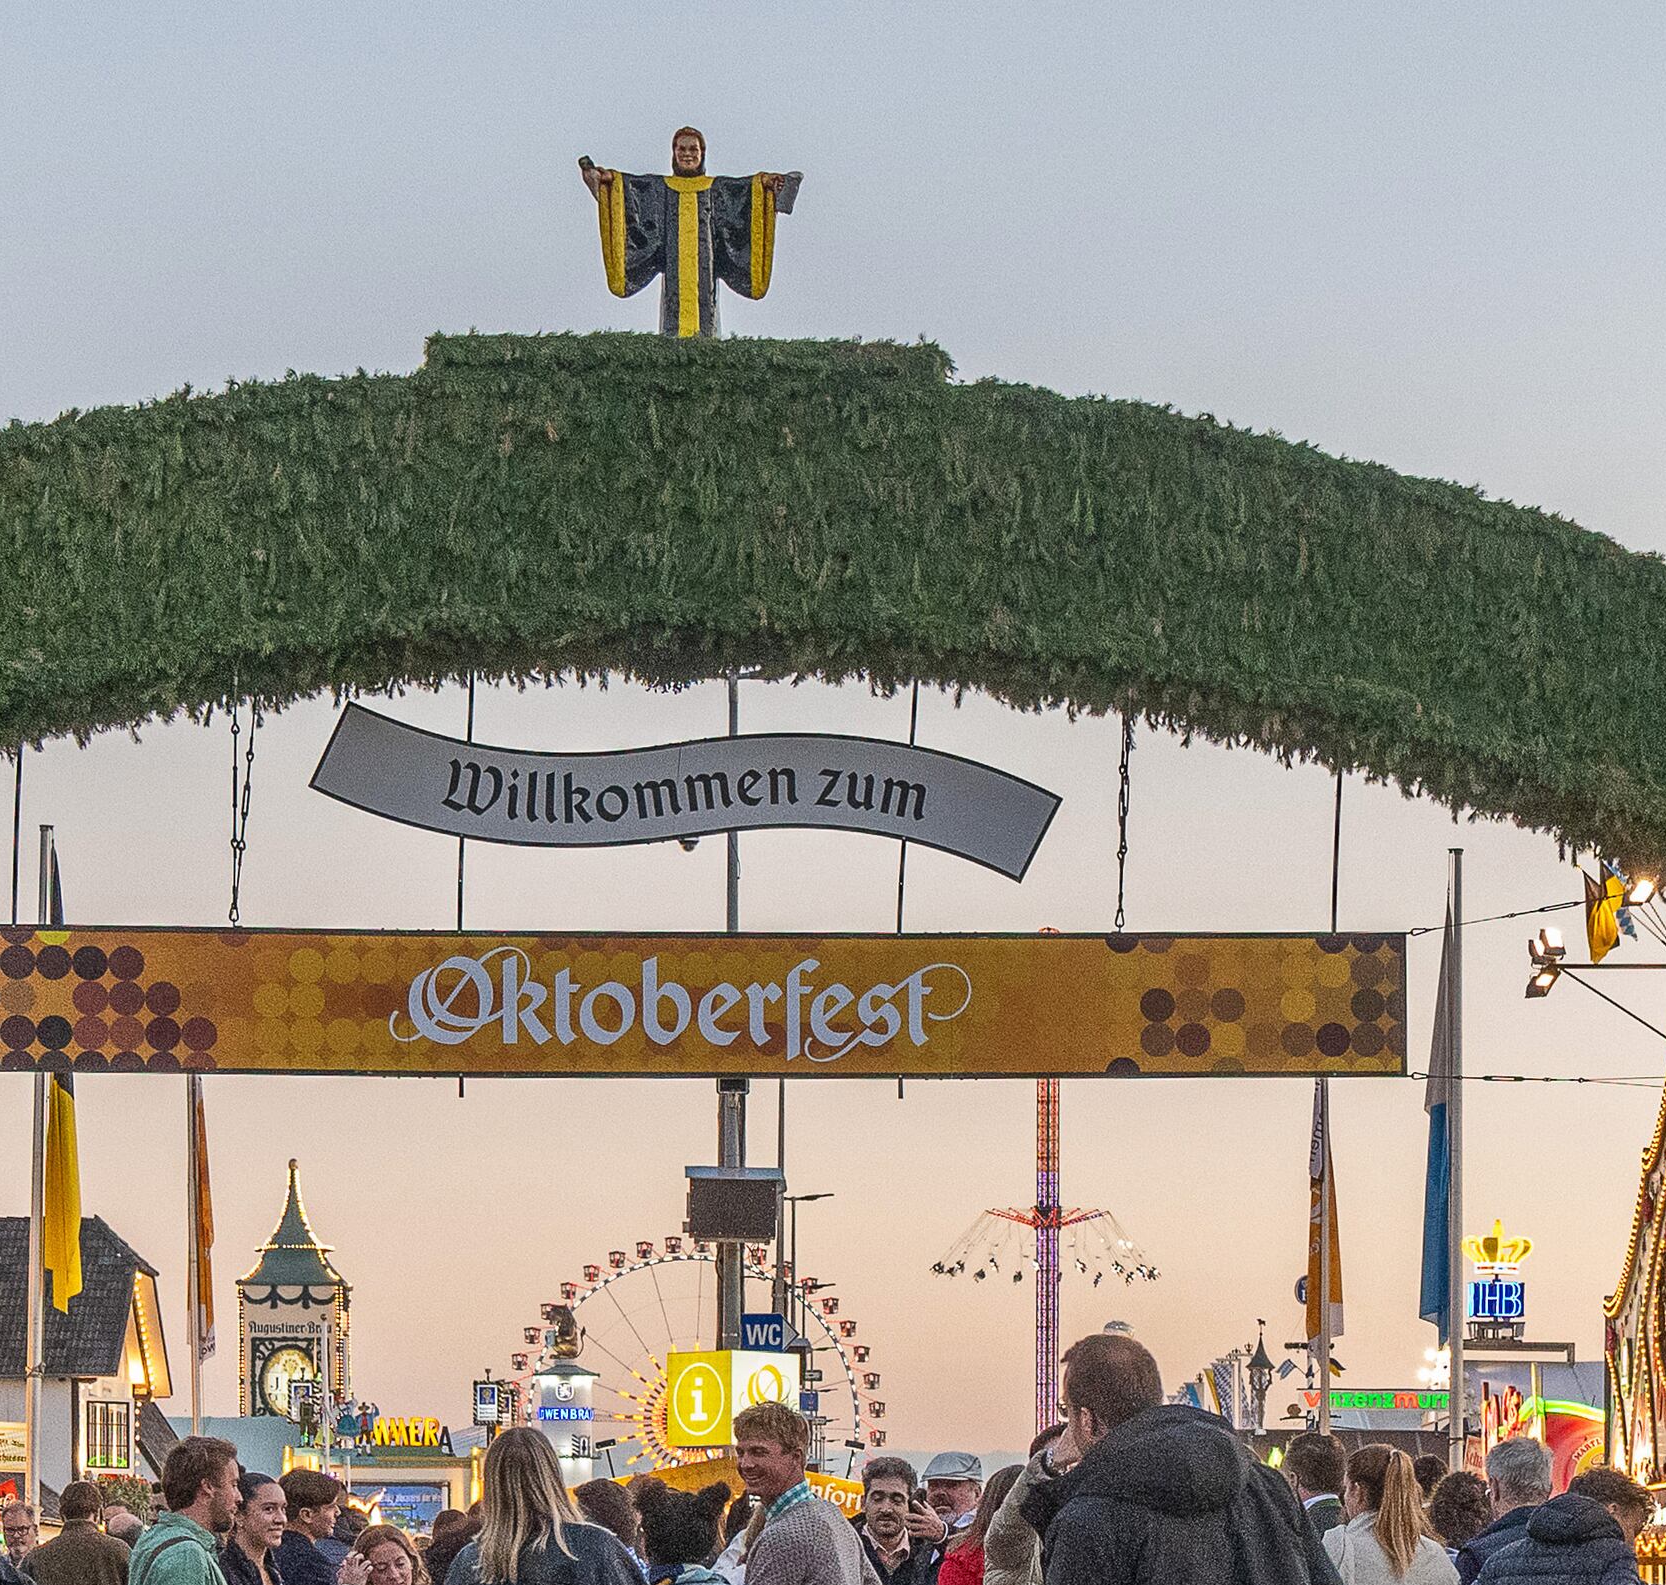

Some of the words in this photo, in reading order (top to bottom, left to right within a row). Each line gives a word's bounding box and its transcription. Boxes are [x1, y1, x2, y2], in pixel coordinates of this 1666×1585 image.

[440, 758, 800, 825] Willkommen
[813, 767, 927, 821] zum
[389, 946, 972, 1063] Oktoberfest
[746, 1324, 781, 1346] WC
[1303, 1391, 1450, 1409] vnzenzmurr
